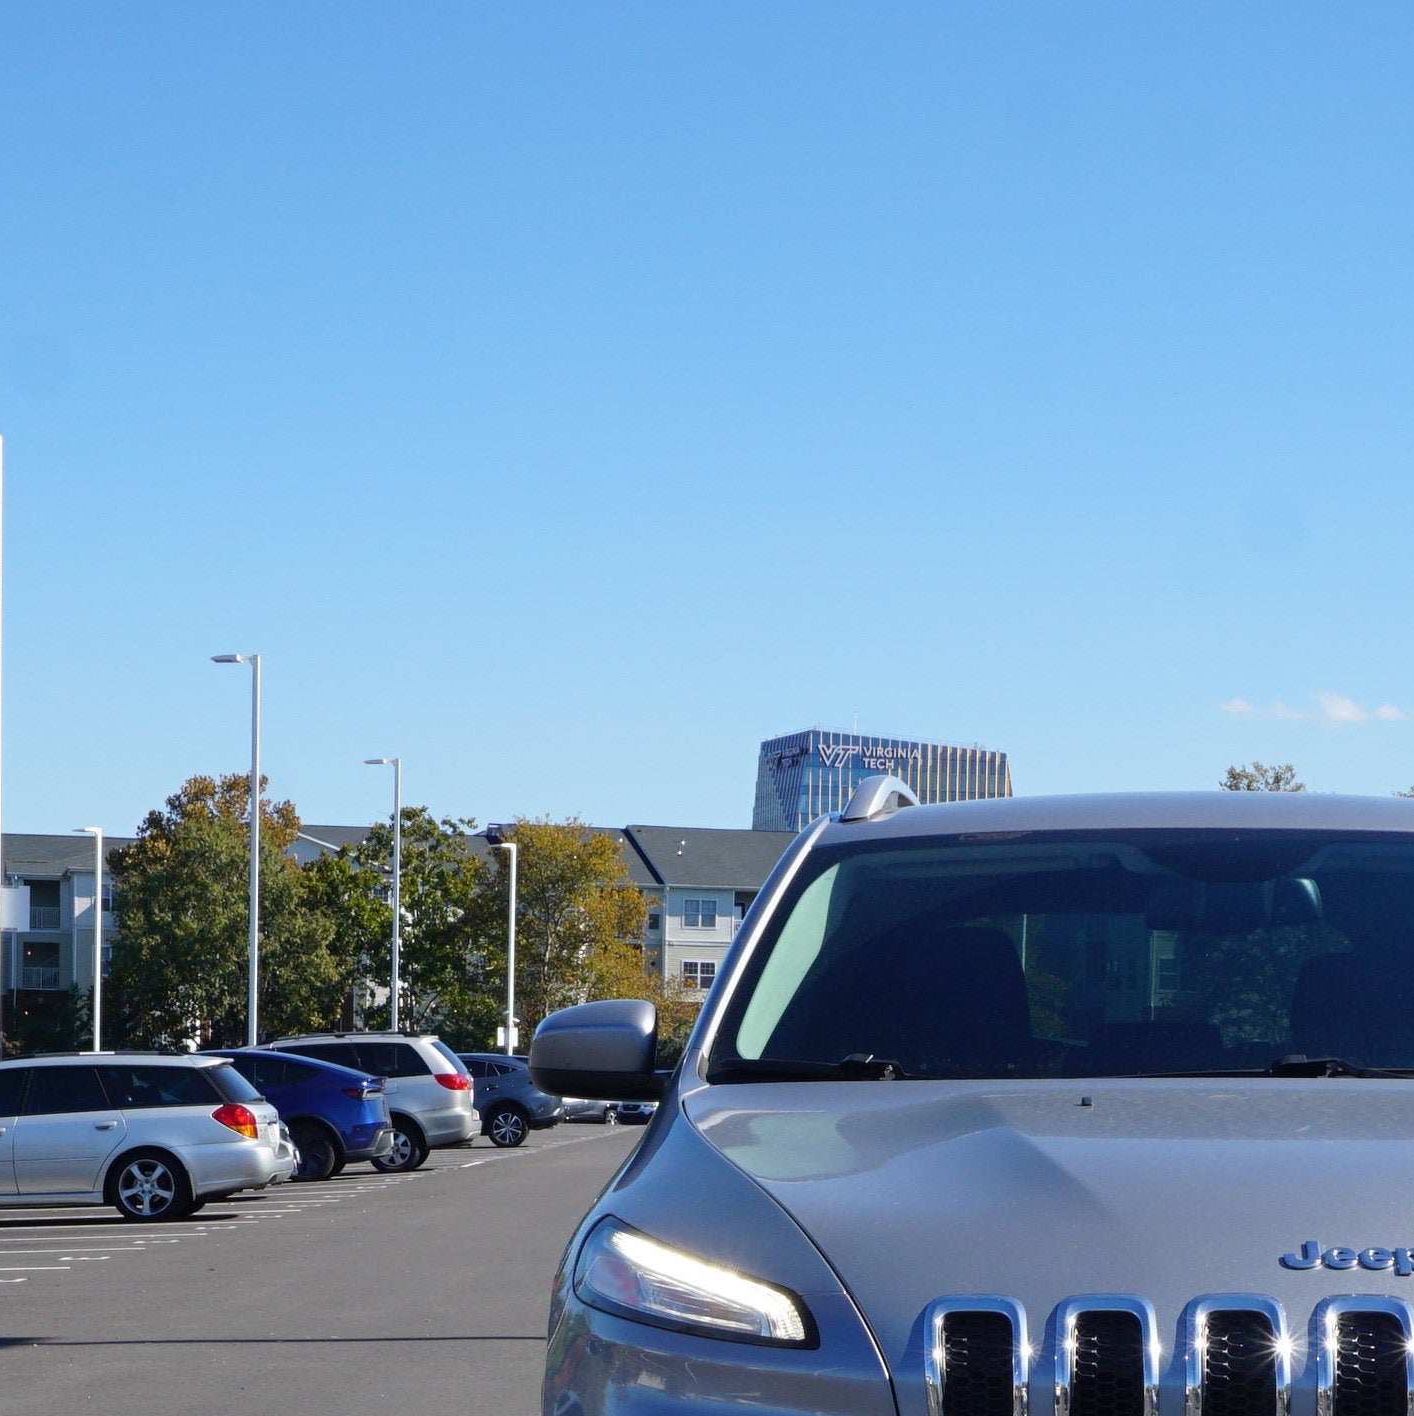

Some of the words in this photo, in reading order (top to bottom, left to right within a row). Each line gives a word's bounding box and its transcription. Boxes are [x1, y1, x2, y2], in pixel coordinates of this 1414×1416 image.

[818, 745, 859, 767] VT
[863, 747, 919, 759] VIRGINIA
[862, 759, 894, 769] TECH
